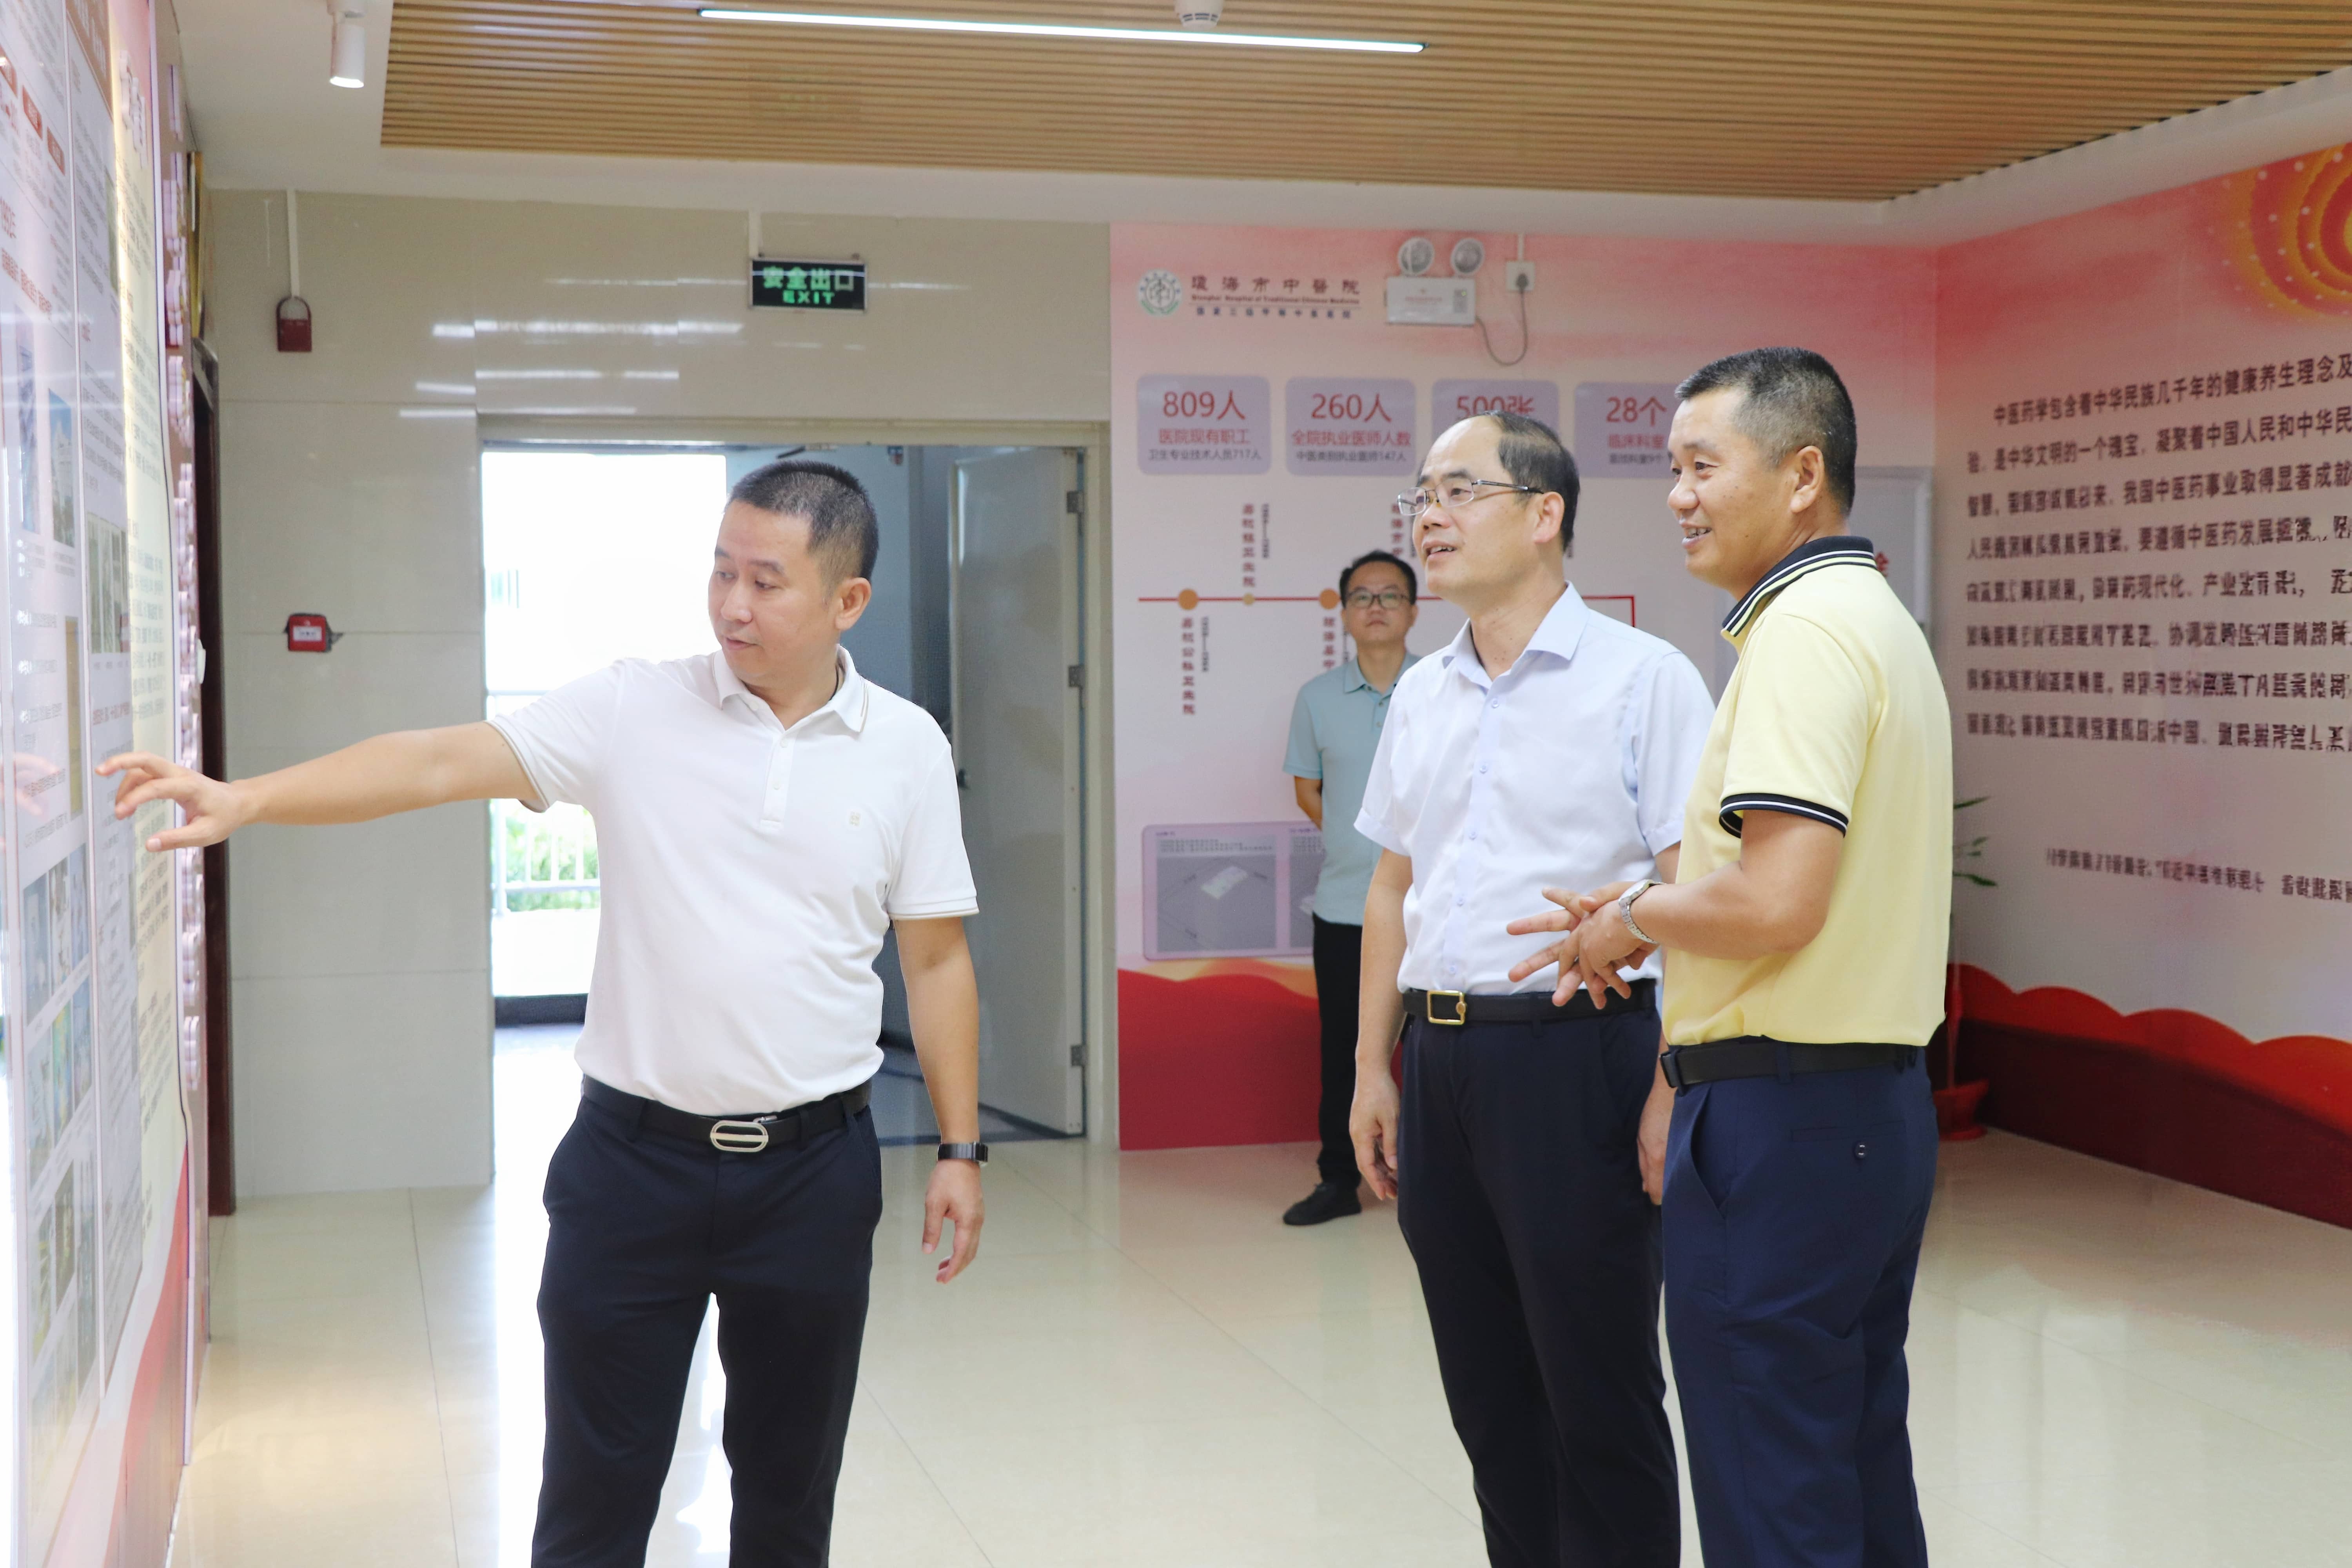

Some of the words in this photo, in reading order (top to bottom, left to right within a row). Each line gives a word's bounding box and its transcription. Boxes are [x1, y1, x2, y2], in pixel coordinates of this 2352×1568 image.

[763, 266, 854, 291] 安全出口
[783, 290, 835, 304] EXIT
[1163, 390, 1246, 420] 809人
[1311, 393, 1392, 423] 260人
[1606, 396, 1667, 427] 28个
